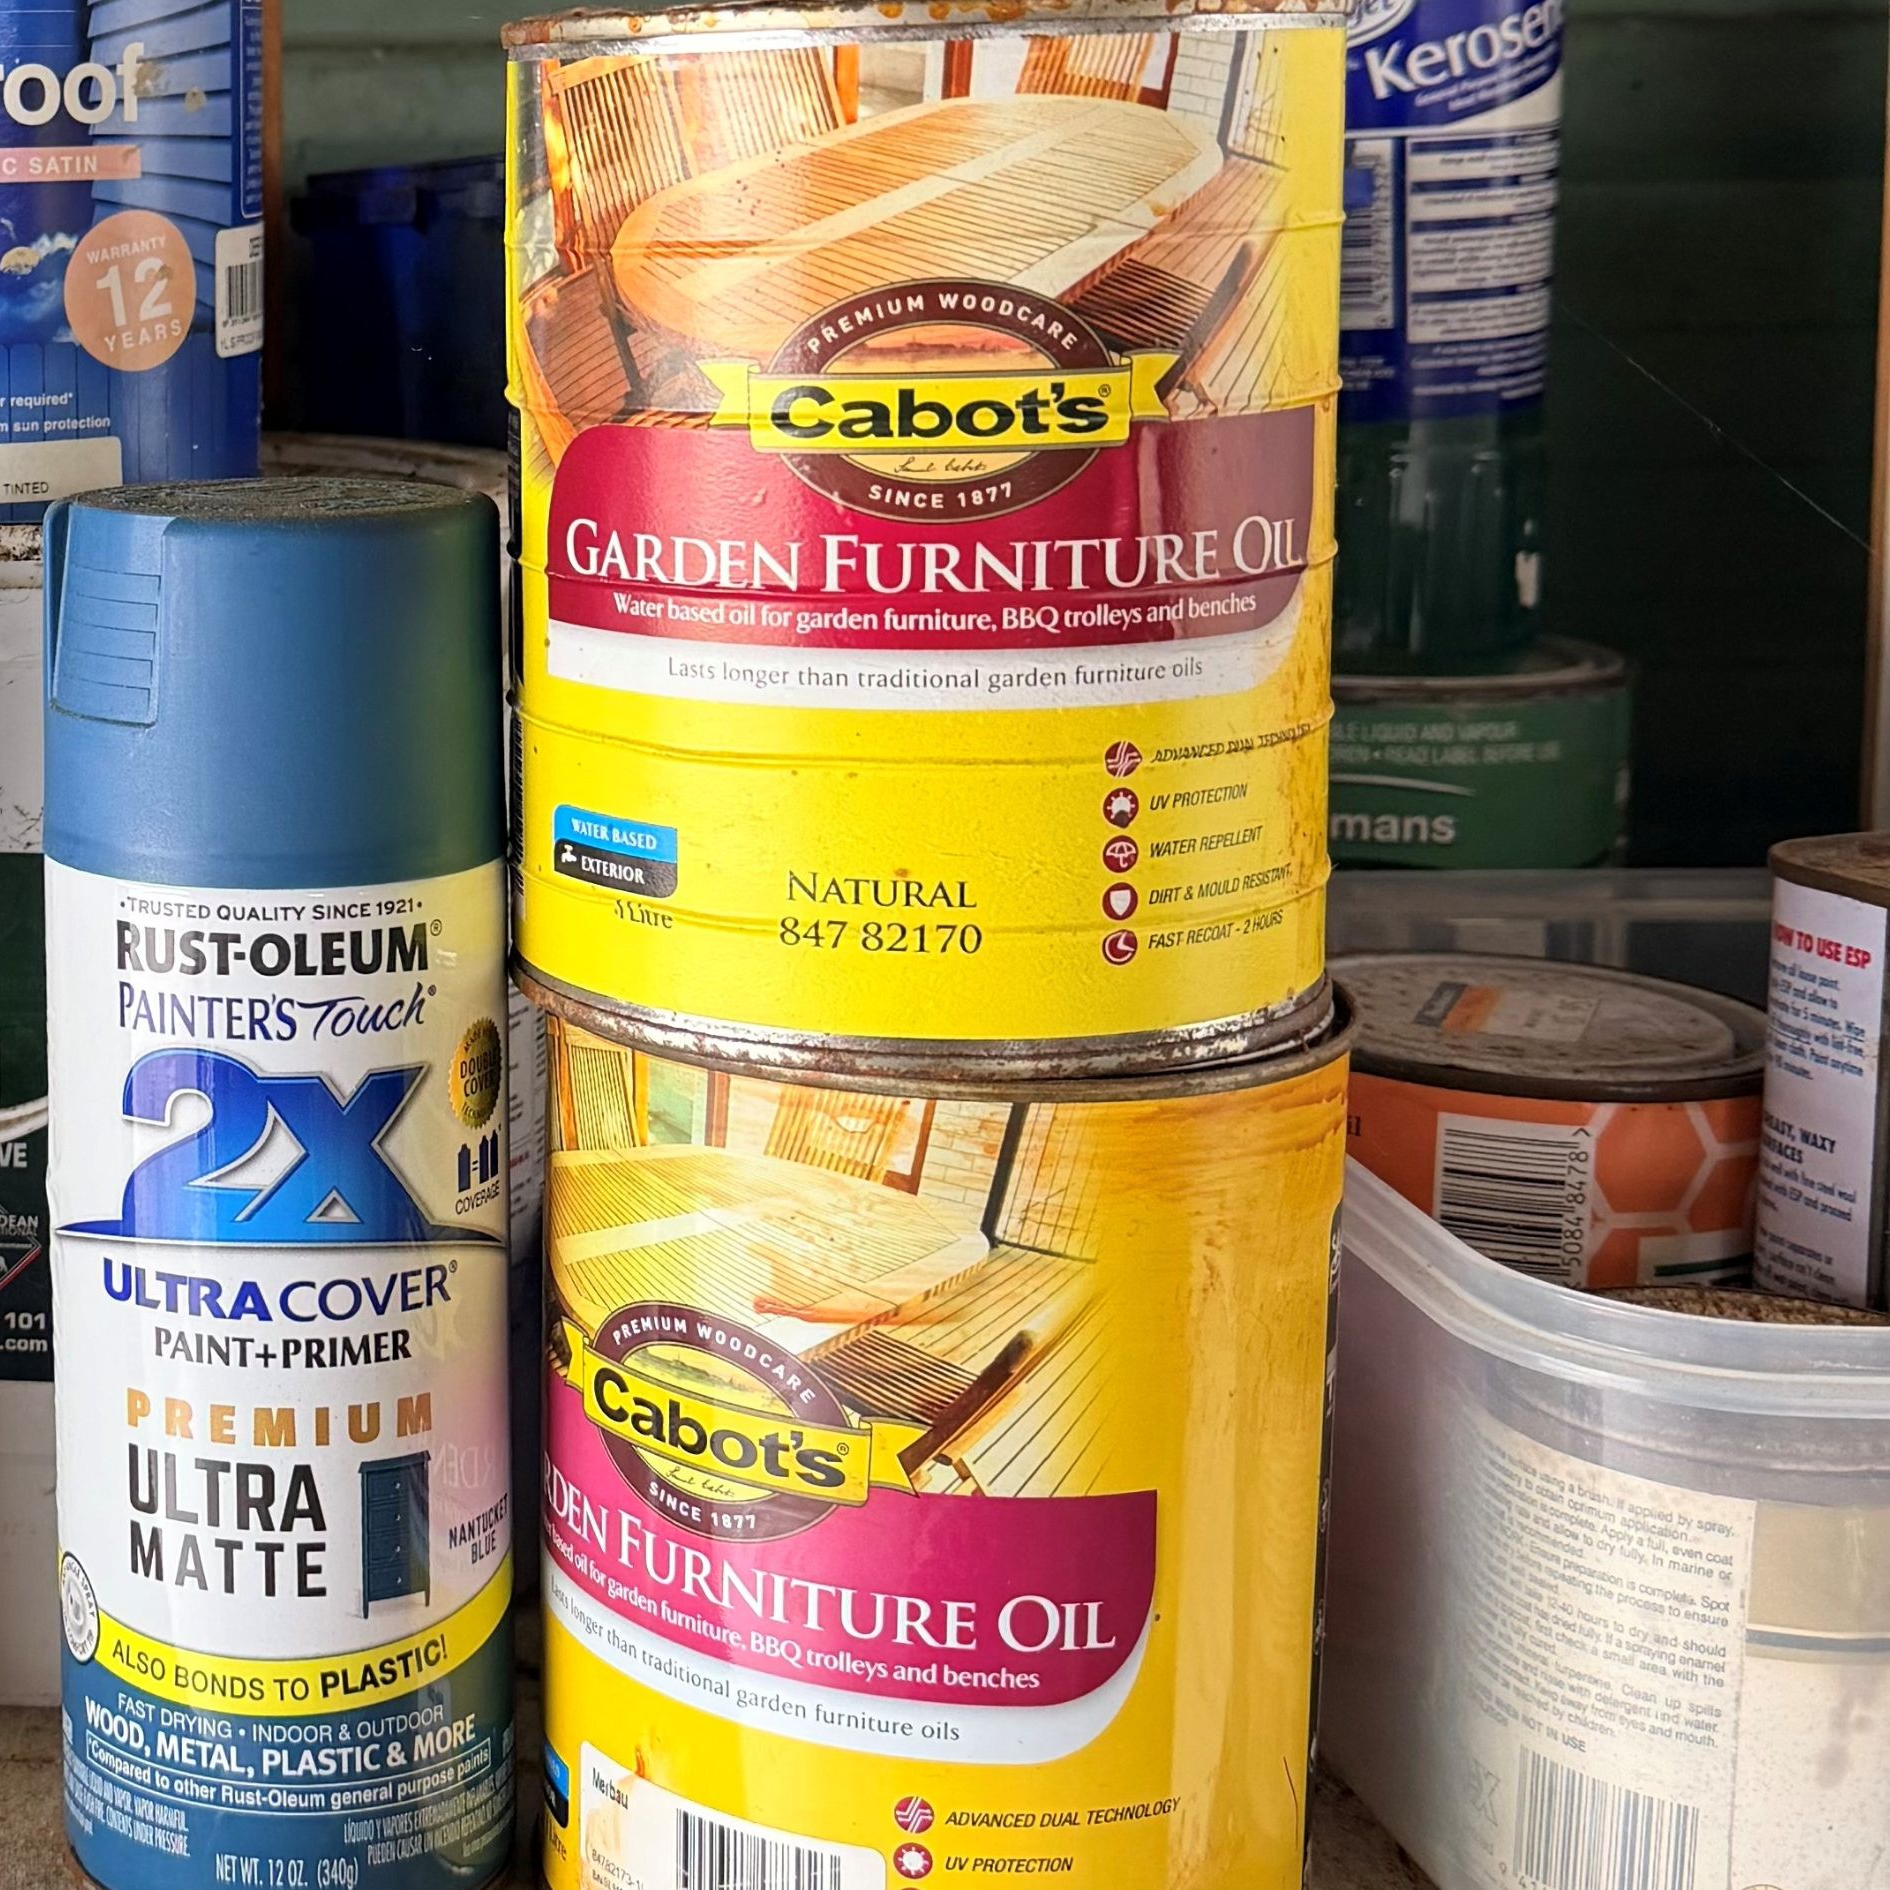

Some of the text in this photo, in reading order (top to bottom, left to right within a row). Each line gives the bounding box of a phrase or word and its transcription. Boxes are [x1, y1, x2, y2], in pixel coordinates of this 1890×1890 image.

[28, 156, 98, 175] SATIN
[86, 235, 167, 264] WARRANTY
[96, 257, 173, 328] 12
[104, 319, 183, 353] YEARS
[808, 293, 1078, 355] PREMIUM WOODCARE
[13, 420, 39, 432] sun
[43, 415, 111, 434] protection
[771, 382, 1109, 439] Cabot's
[4, 482, 50, 494] TINTED
[868, 481, 1012, 509] SINCE 1877
[566, 515, 1302, 594] GARDEN FURNITURE OIL
[613, 591, 1256, 633] Water based oil for garden furniture, BBQ trolleys and benches
[1150, 783, 1248, 810] UV PROTECTION
[572, 818, 657, 850] WATER BASED
[581, 856, 646, 884] EXTERIOR
[788, 871, 977, 910] NATURAL
[117, 919, 428, 976] RUST-OLEUM
[779, 918, 982, 956] 847 82170
[1817, 938, 1842, 962] USE
[1845, 946, 1871, 969] ESP
[119, 981, 425, 1041] PAINTER'S Touch
[122, 1047, 432, 1241] 2X
[103, 1257, 271, 1321] ULTRA
[4, 1312, 46, 1330] 101
[126, 1388, 432, 1447] PREMIUM
[593, 1367, 846, 1488] Cabot's
[128, 1442, 327, 1532] ULTRA
[448, 1492, 508, 1550] NANTUCKET
[1628, 1502, 1693, 1529] applied by
[130, 1520, 328, 1598] MATTE
[471, 1534, 497, 1565] BLUE
[1668, 1560, 1713, 1578] marine
[1706, 1552, 1733, 1566] coat
[618, 1509, 1116, 1653] FURNITURE OIL
[1684, 1611, 1728, 1627] ensure
[1701, 1596, 1730, 1612] Spot
[112, 1634, 448, 1701] ALSO BONDS TO PLASTIC!
[1683, 1638, 1726, 1658] should
[642, 1649, 960, 1741] traditional garden furniture oils
[85, 1696, 151, 1758] WOOD,
[156, 1731, 254, 1778] METAL,
[262, 1742, 382, 1777] PLASTIC
[386, 1741, 407, 1766] &
[414, 1713, 476, 1760] MORE
[155, 1770, 169, 1788] to
[174, 1779, 216, 1799] other
[221, 1784, 326, 1809] Rust-Oleum
[330, 1786, 392, 1809] general
[398, 1764, 454, 1798] purpose
[457, 1748, 489, 1778] paints
